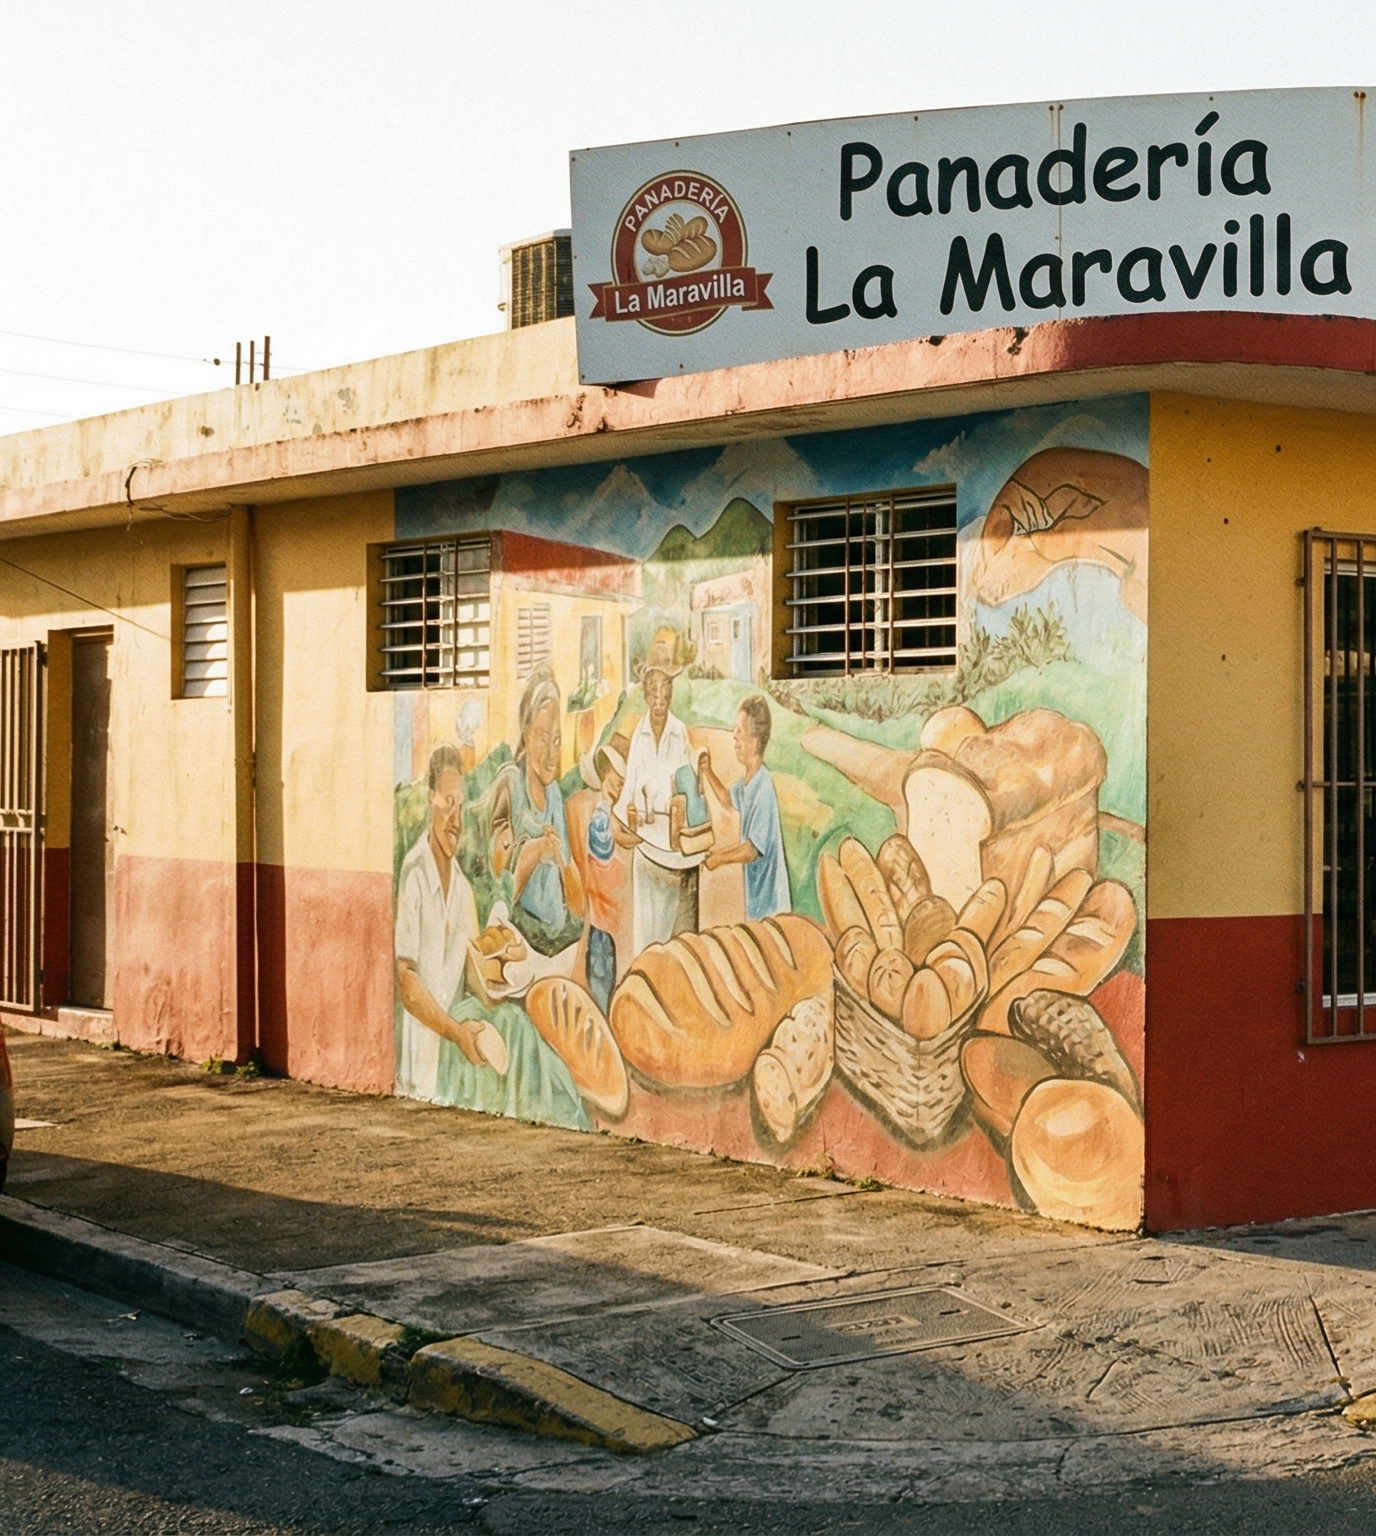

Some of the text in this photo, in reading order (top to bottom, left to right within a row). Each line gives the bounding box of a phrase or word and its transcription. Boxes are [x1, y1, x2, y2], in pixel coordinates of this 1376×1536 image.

[624, 181, 730, 232] PANADERÍA
[838, 110, 1272, 223] Panadería
[614, 273, 746, 315] La Maravilla
[804, 211, 1353, 325] La Maravilla
